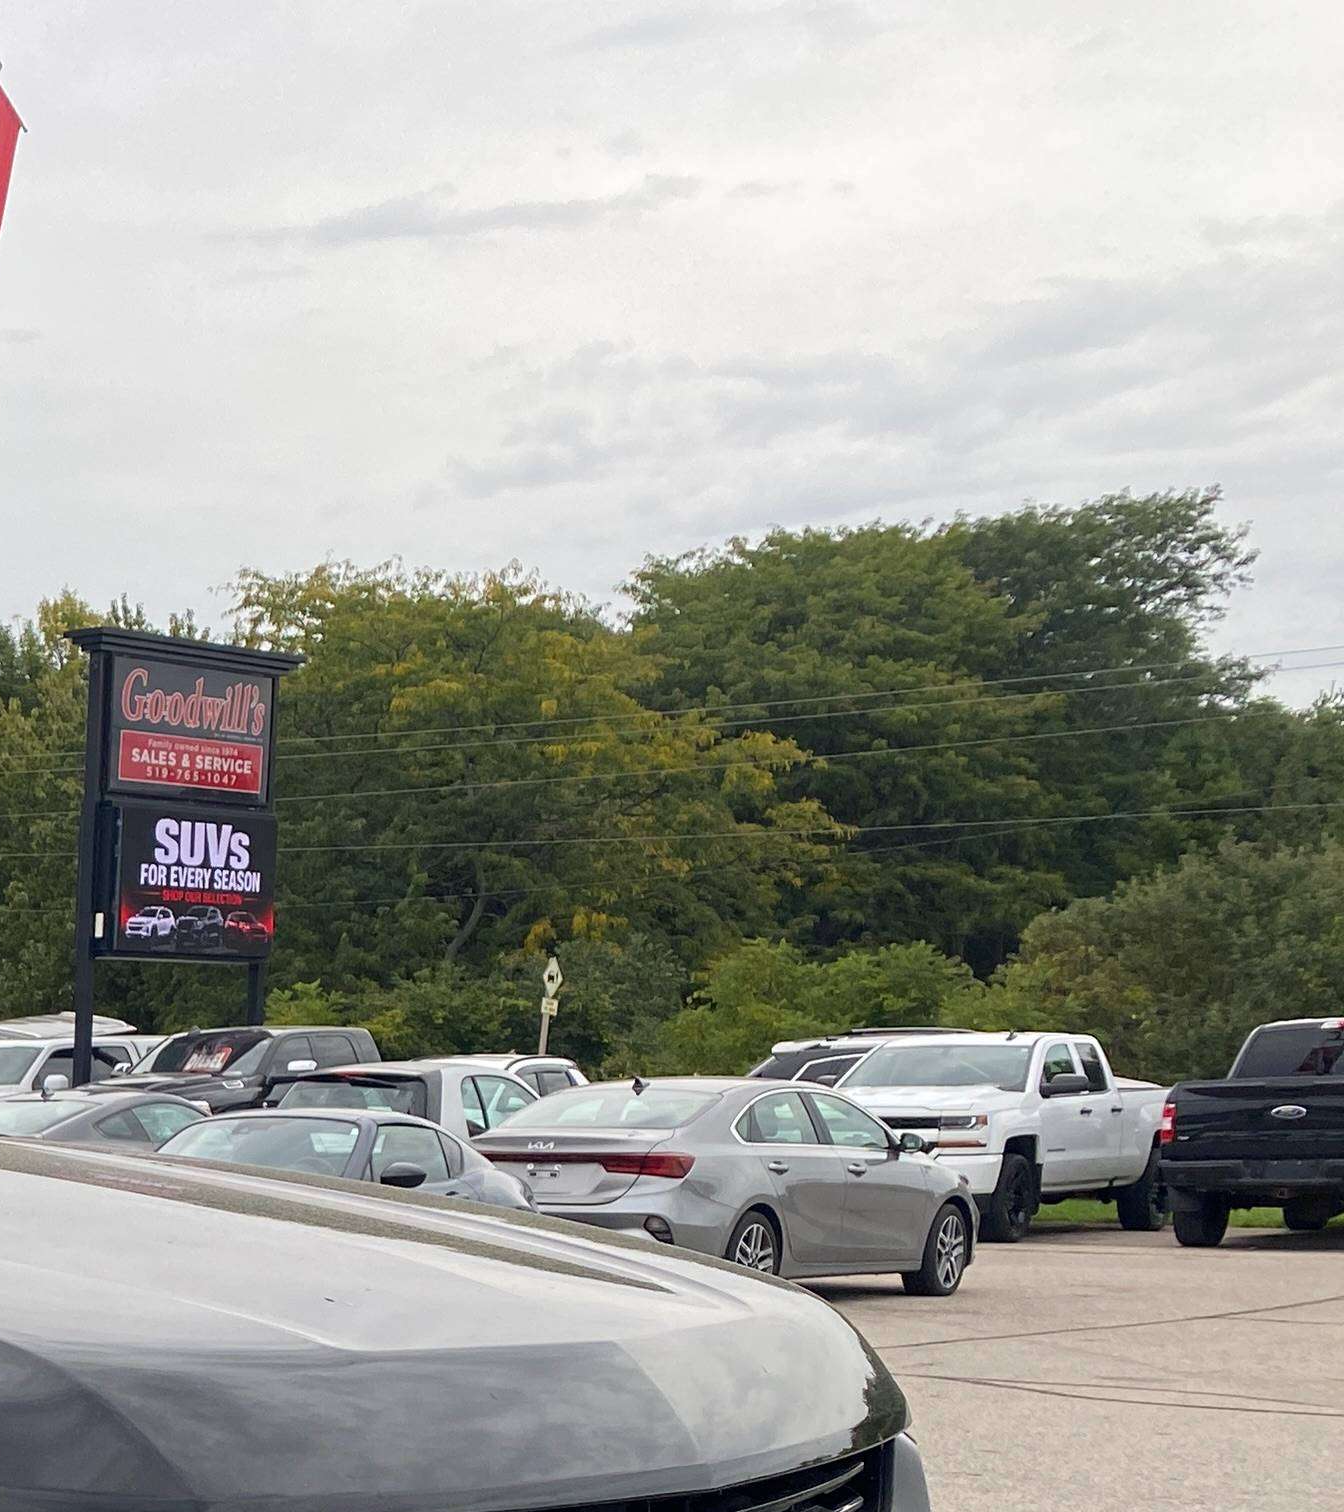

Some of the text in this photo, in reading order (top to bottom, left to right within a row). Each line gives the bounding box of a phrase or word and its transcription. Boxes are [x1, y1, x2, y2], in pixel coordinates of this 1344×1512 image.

[121, 667, 265, 736] Goodwill's
[147, 738, 173, 752] Family
[131, 747, 253, 775] SALES & SERVICE
[146, 766, 237, 786] 519-765-1047
[154, 817, 250, 870] SUVs
[140, 863, 261, 893] FOR EVERY SEASON
